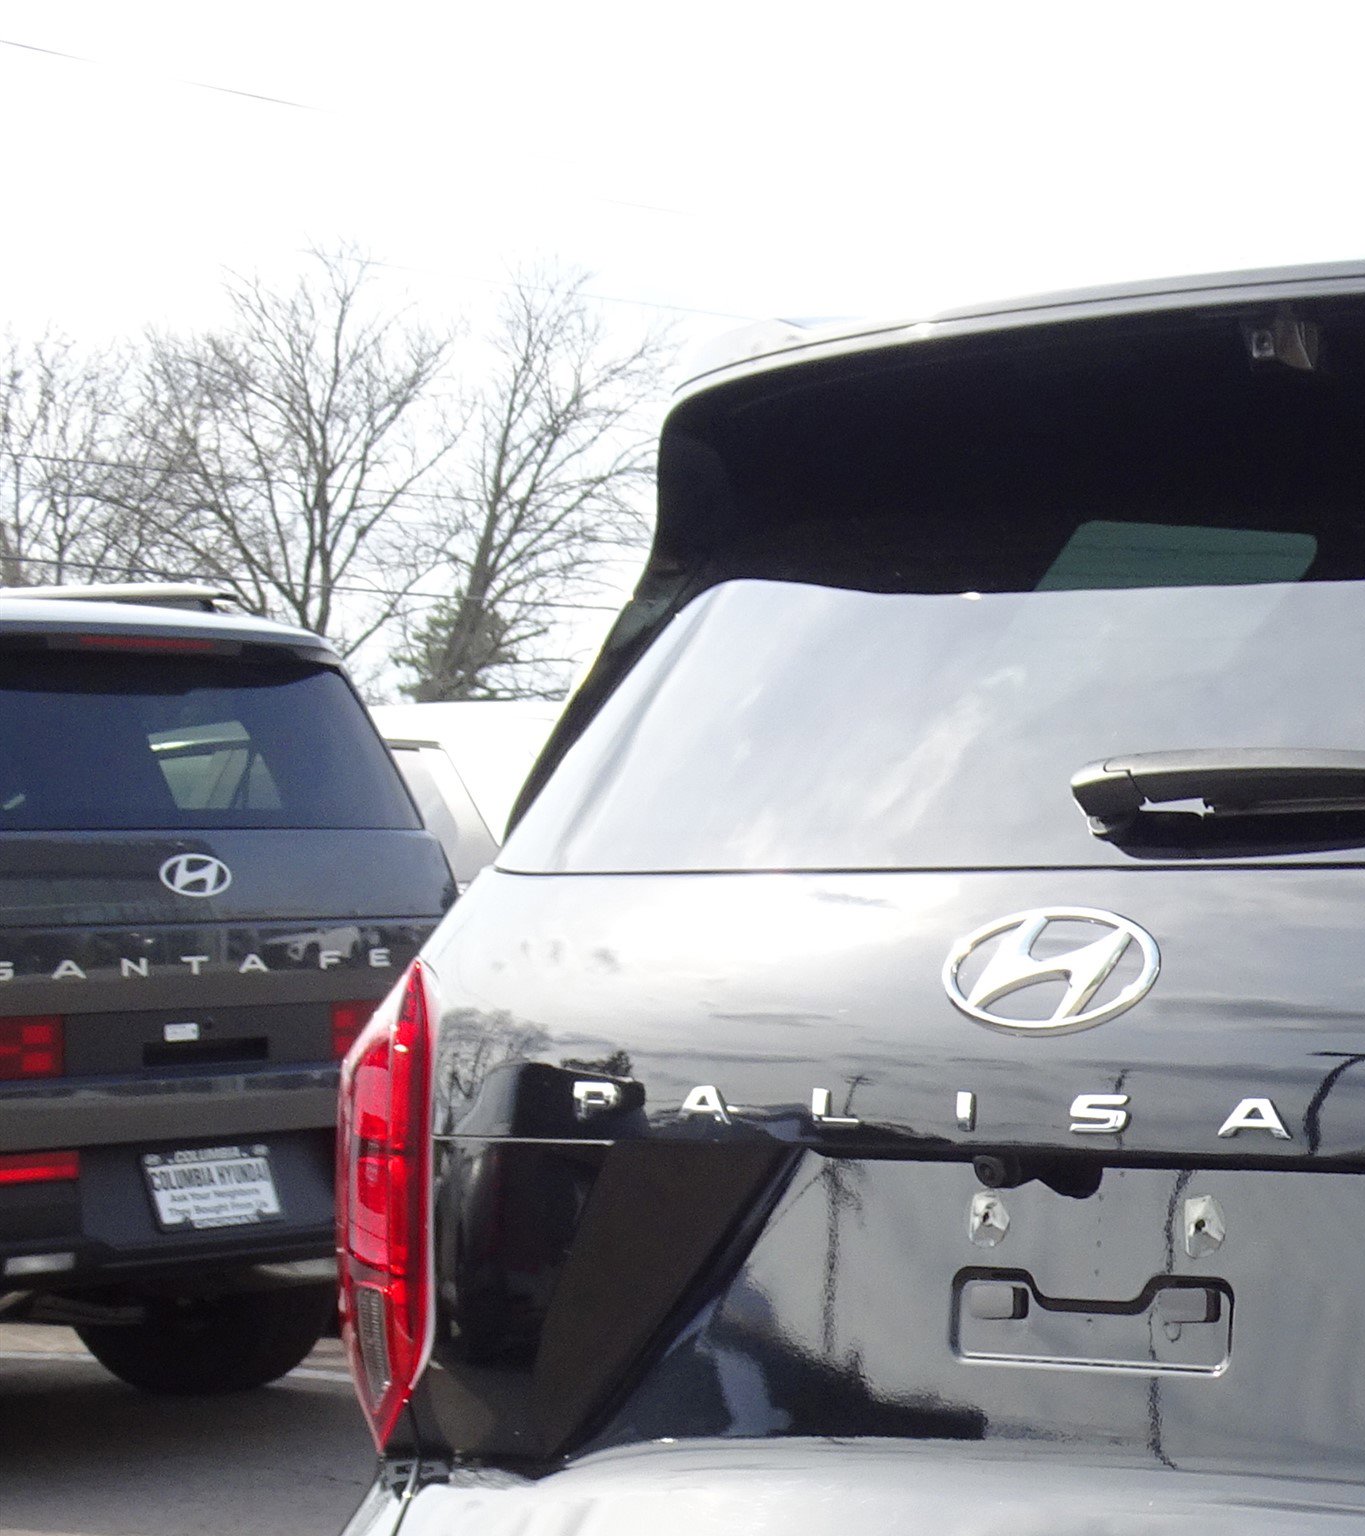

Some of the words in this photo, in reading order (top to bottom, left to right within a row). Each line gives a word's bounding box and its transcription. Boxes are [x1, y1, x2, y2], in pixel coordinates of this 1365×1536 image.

[319, 948, 391, 970] FE
[150, 1166, 216, 1191] COLUMBIA
[216, 1160, 271, 1186] HYUNDAI
